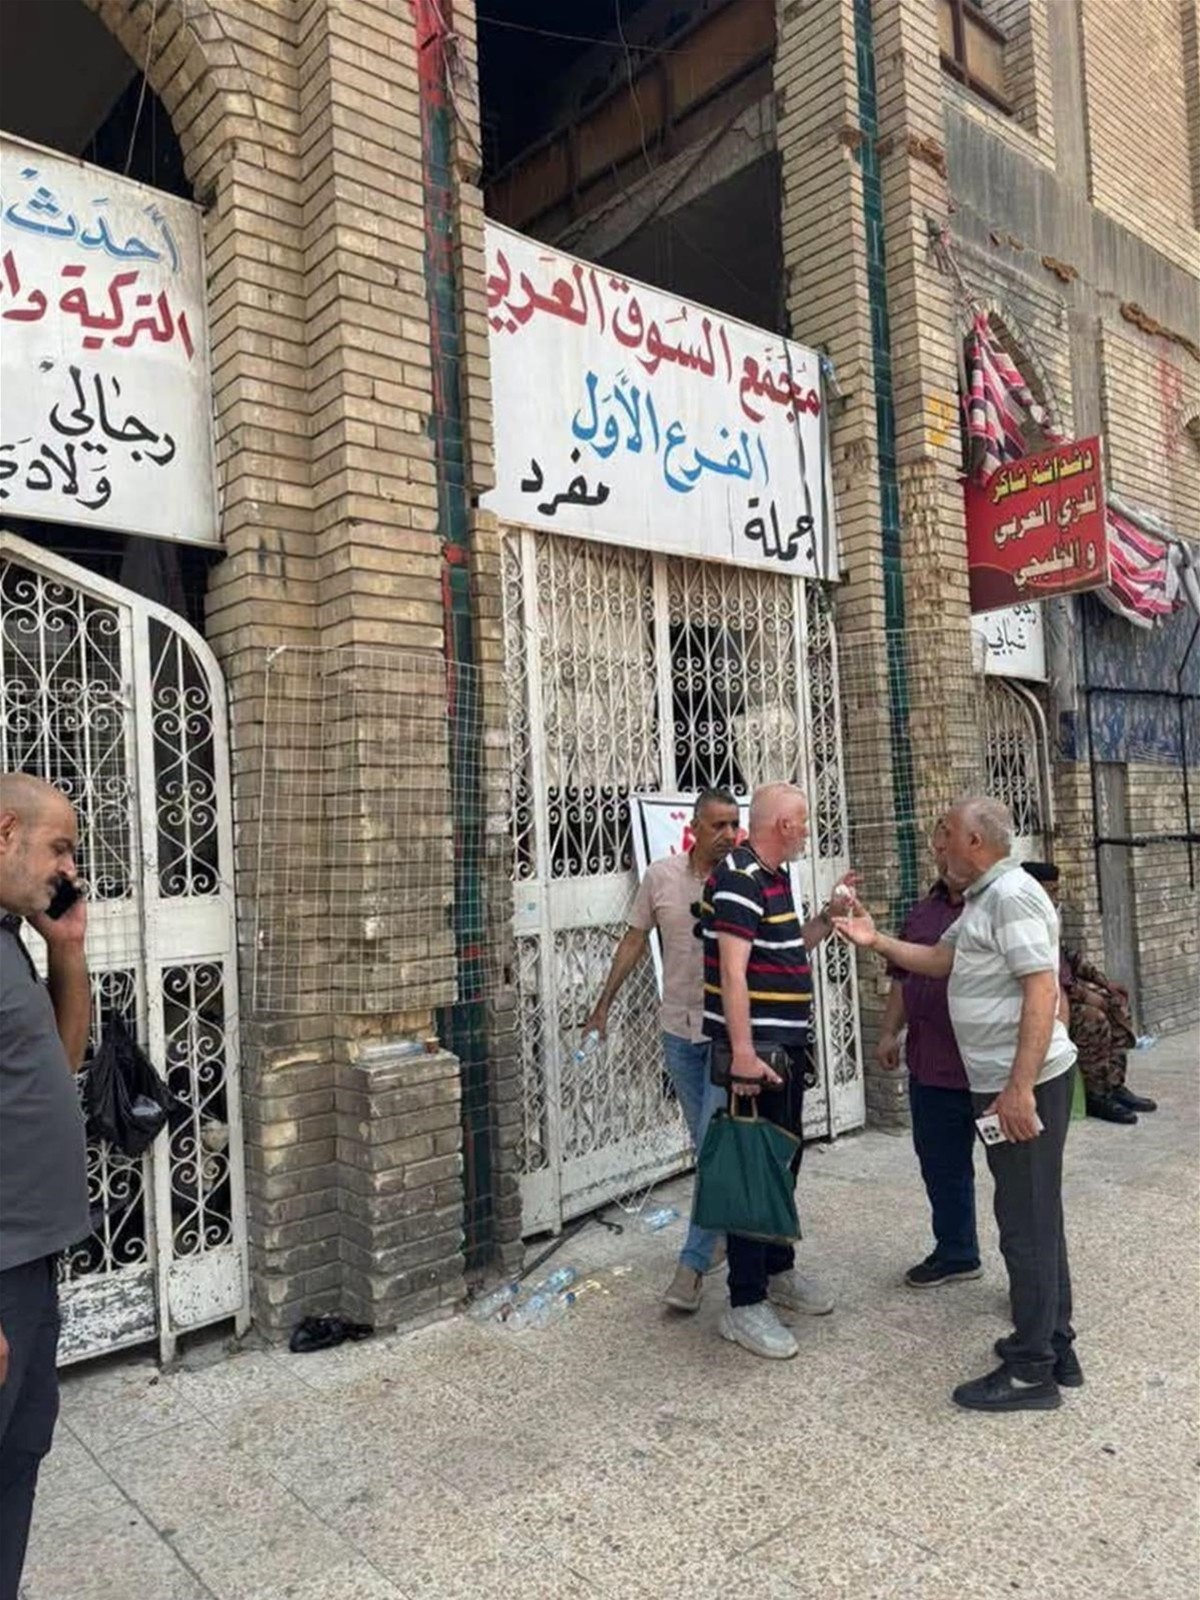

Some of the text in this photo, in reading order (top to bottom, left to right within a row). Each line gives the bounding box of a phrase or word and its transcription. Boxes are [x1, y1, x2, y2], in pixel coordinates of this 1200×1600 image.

[60, 265, 195, 361] التركية
[664, 421, 770, 493] الفرع
[992, 449, 1094, 503] دشداشة شاكر
[521, 447, 815, 561] جملة مفرد
[994, 483, 1097, 549] للزي العربي
[1013, 538, 1081, 591] الخليجي
